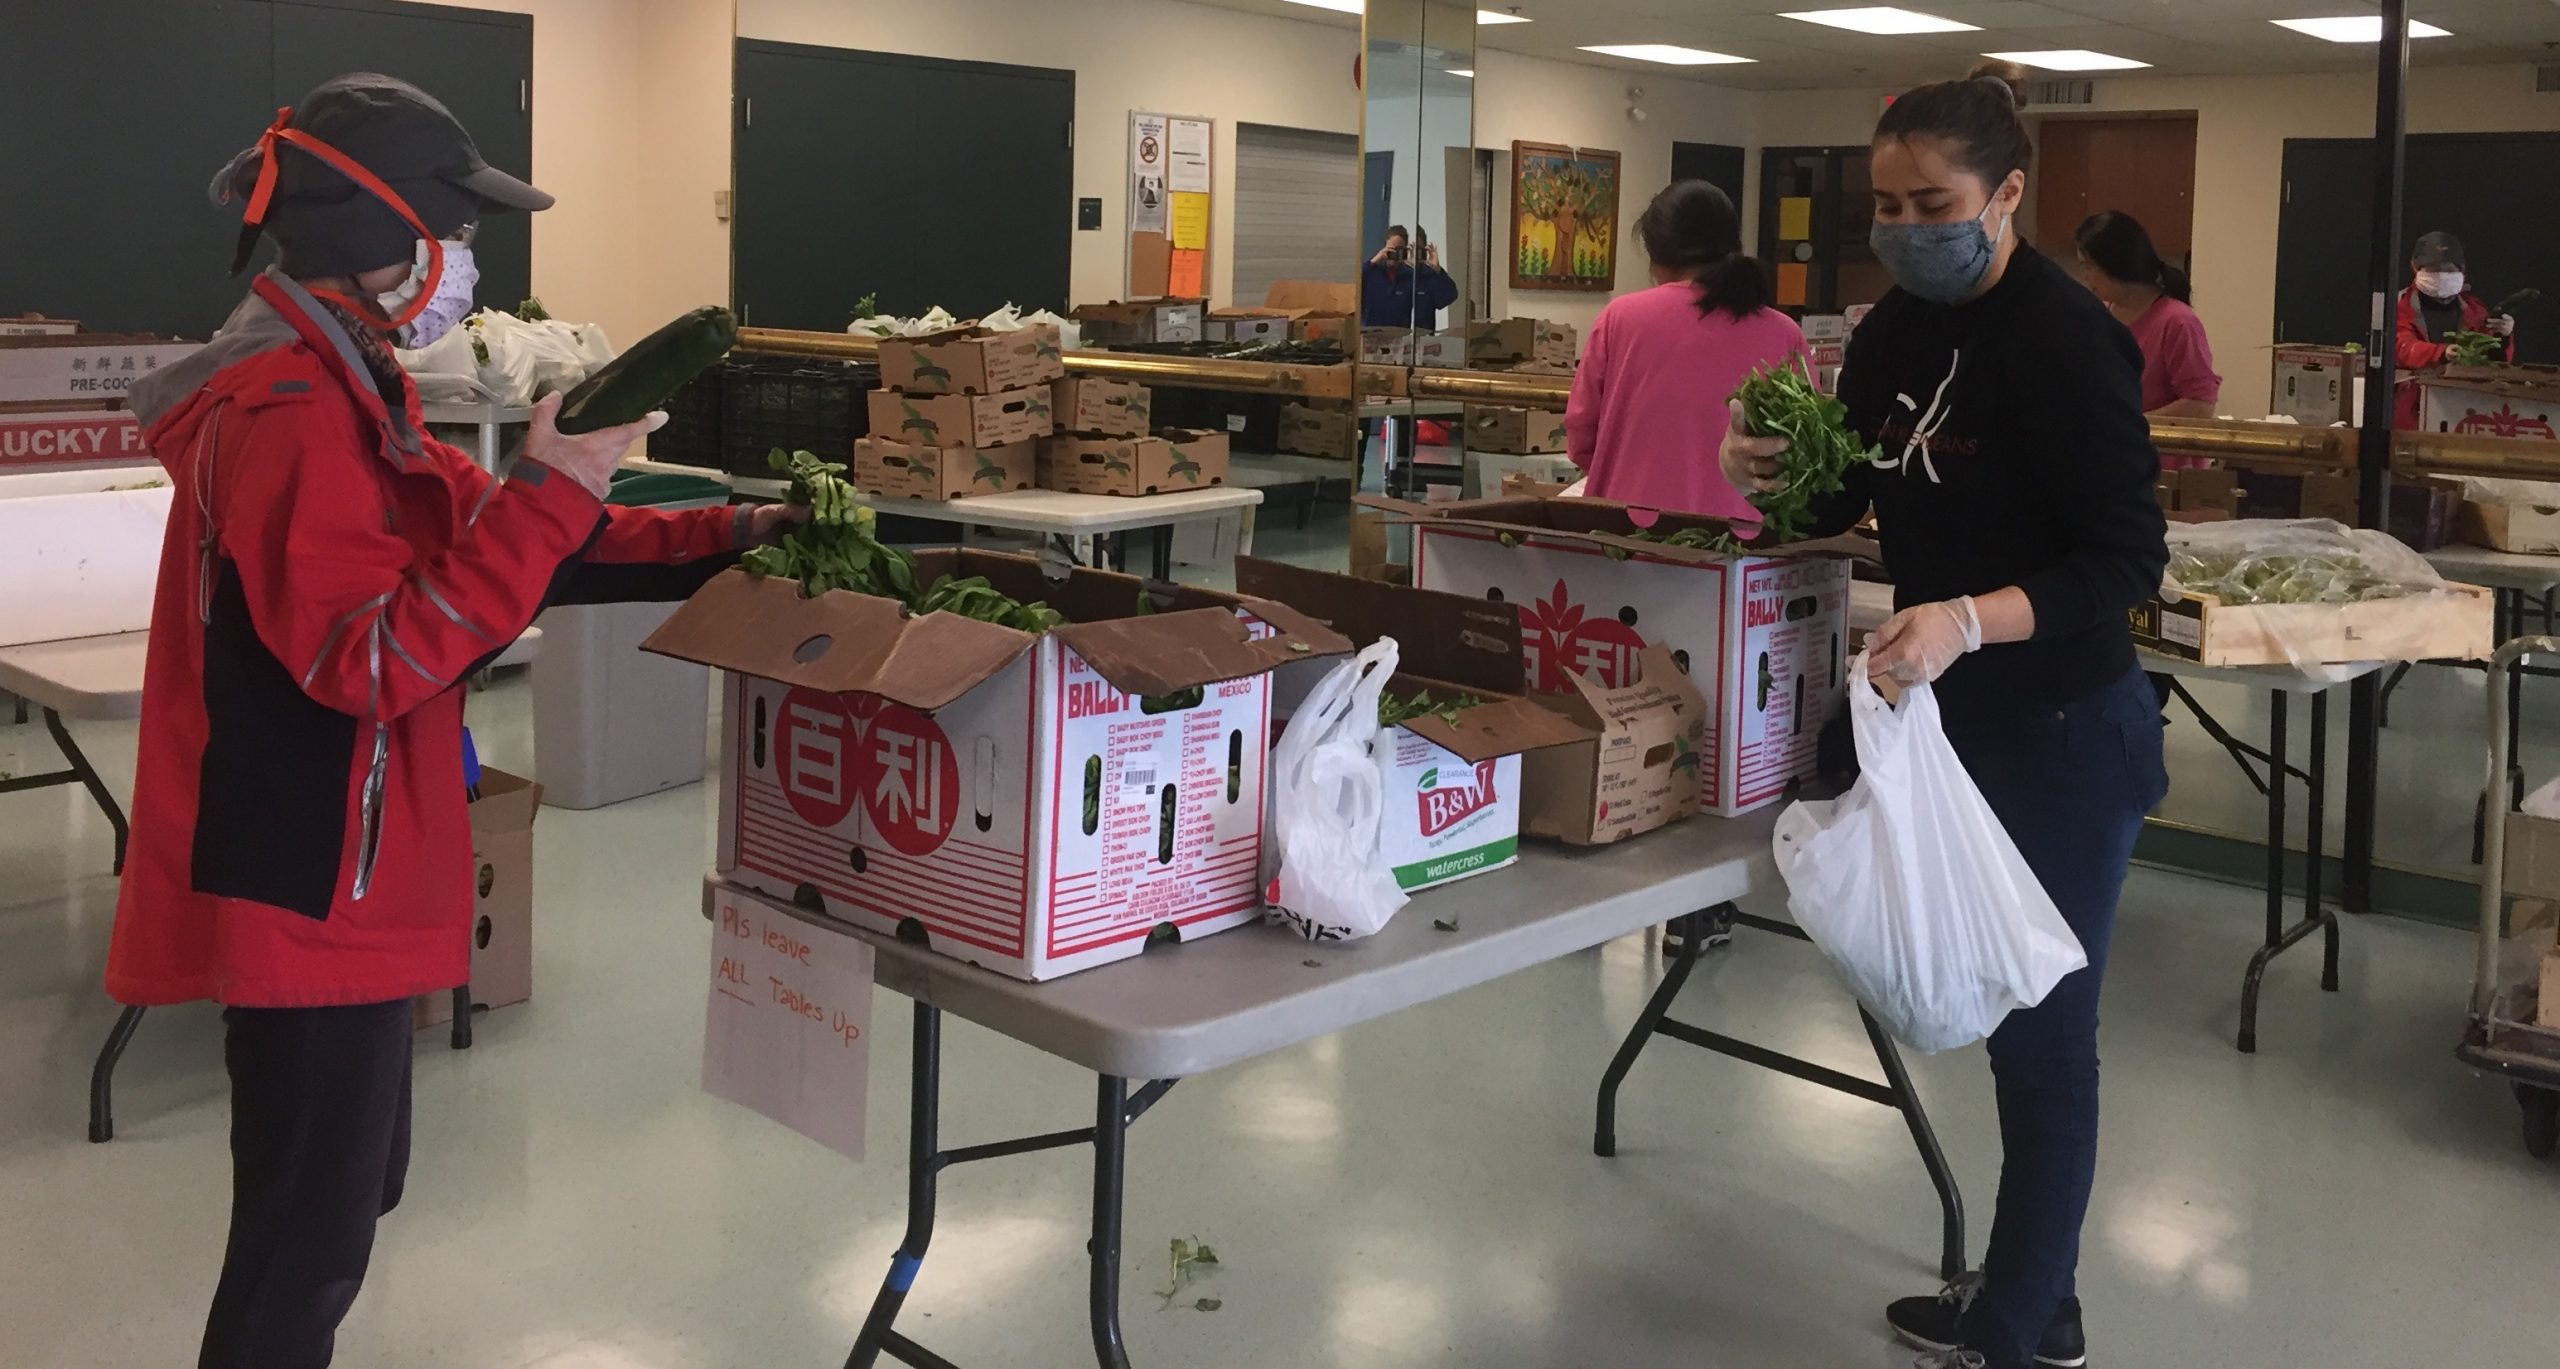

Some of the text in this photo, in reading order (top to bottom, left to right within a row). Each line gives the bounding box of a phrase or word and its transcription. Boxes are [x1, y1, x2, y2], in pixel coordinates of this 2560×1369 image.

[69, 377, 136, 392] PRE-COO
[0, 426, 108, 458] UCKY
[1747, 595, 1784, 628] BALLY
[1068, 680, 1132, 719] BALLY
[1218, 682, 1252, 698] MEXICO
[789, 703, 942, 836] 百利
[1438, 769, 1474, 779] CLEARANCE
[1426, 766, 1489, 833] B&W
[1426, 852, 1485, 880] watercress
[722, 905, 811, 967] Pls leave
[718, 957, 860, 1048] ALL Tables Up
